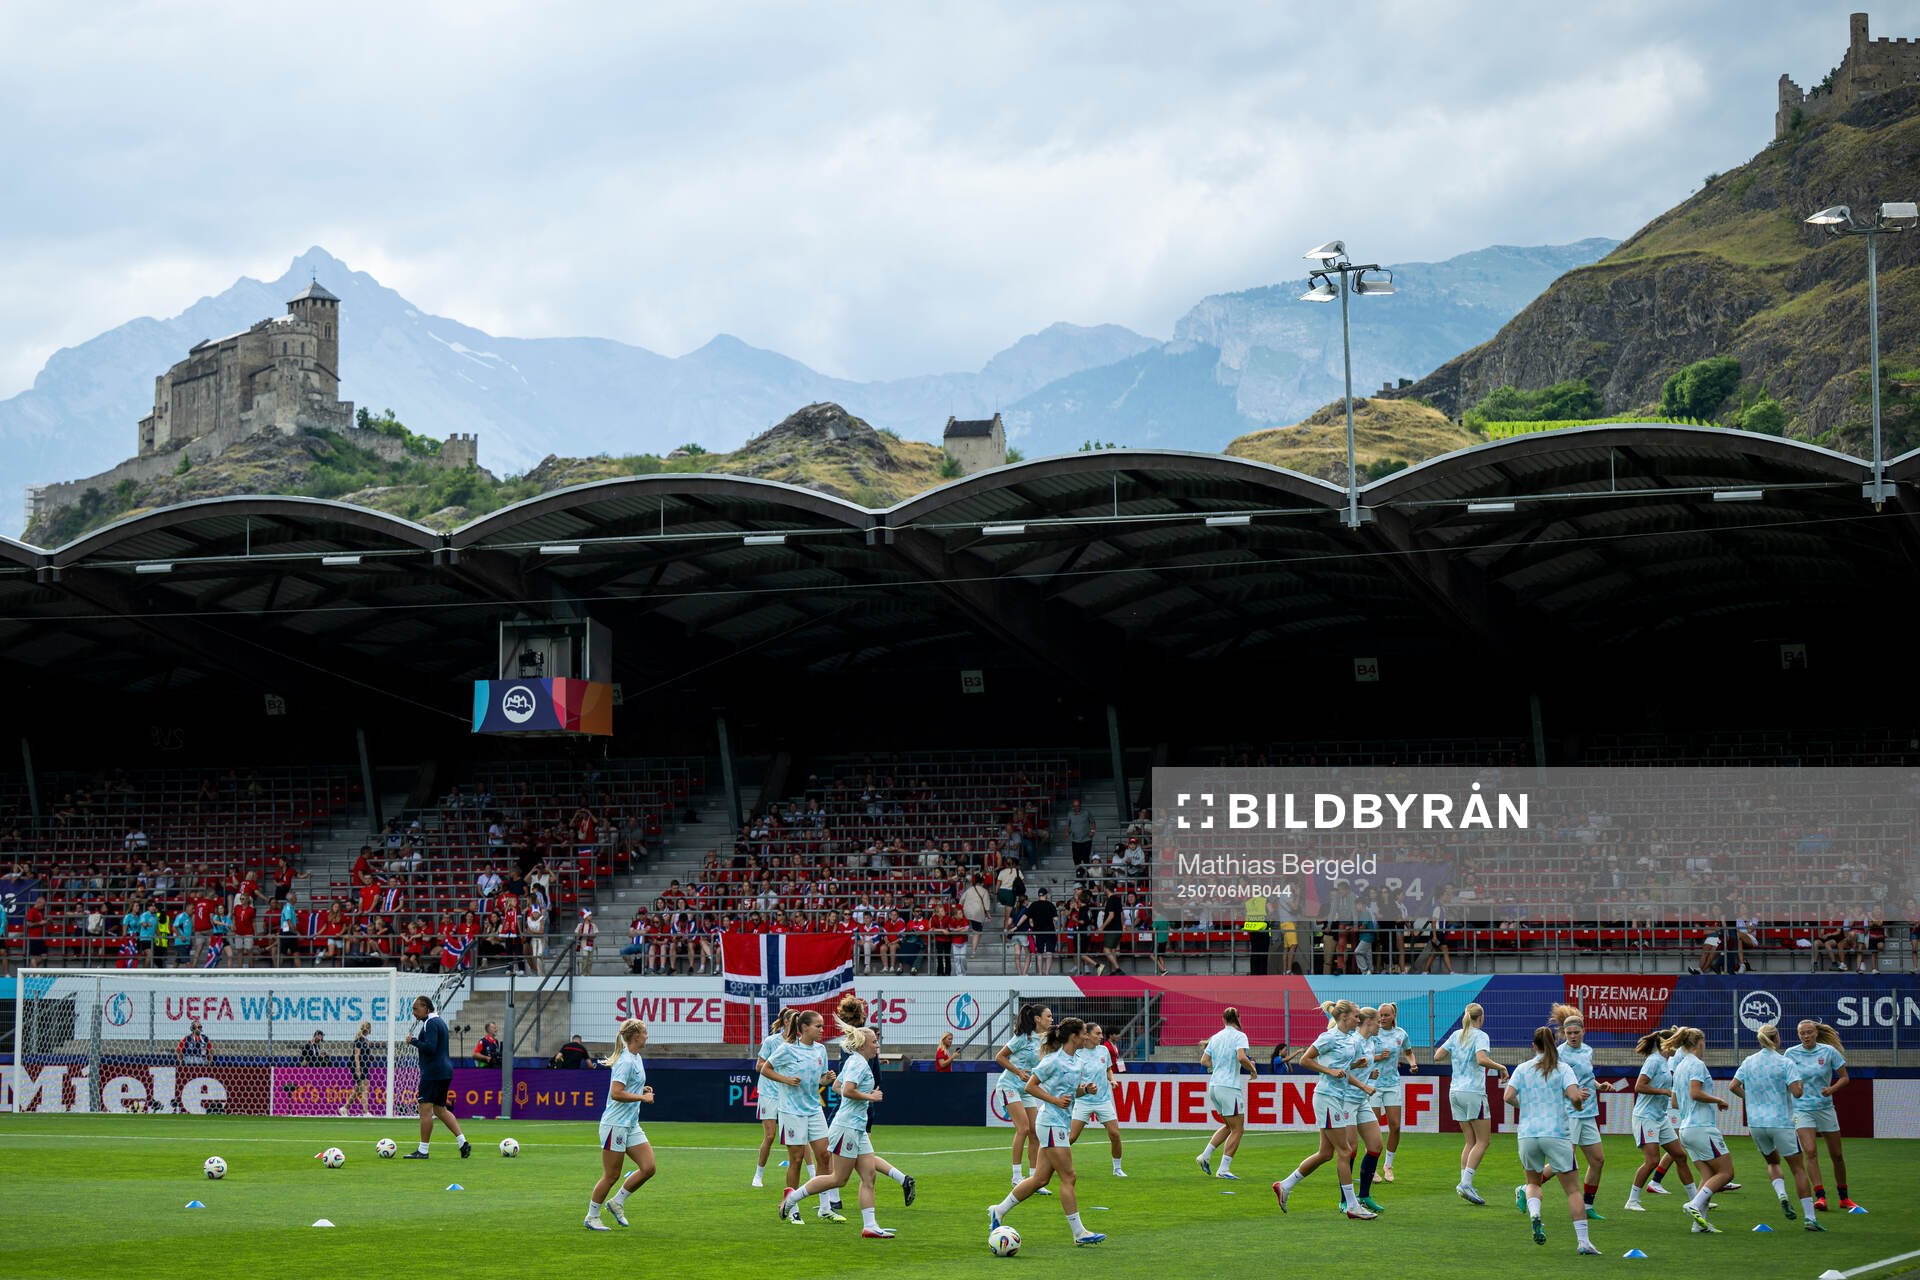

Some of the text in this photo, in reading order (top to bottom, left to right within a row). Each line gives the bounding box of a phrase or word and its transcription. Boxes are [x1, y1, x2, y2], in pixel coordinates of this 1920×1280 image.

[1358, 664, 1376, 675] B4
[964, 676, 982, 687] B3
[1569, 984, 1669, 1001] HOTZENWALD
[164, 997, 232, 1022] UEFA
[239, 997, 362, 1022] WOMEN'S
[615, 997, 722, 1023] SWITZE
[1588, 1003, 1648, 1021] HÄNNER
[1836, 996, 1920, 1027] SION
[729, 1075, 752, 1083] UEFA
[0, 1066, 229, 1114] Miele
[536, 1090, 594, 1106] MUTE
